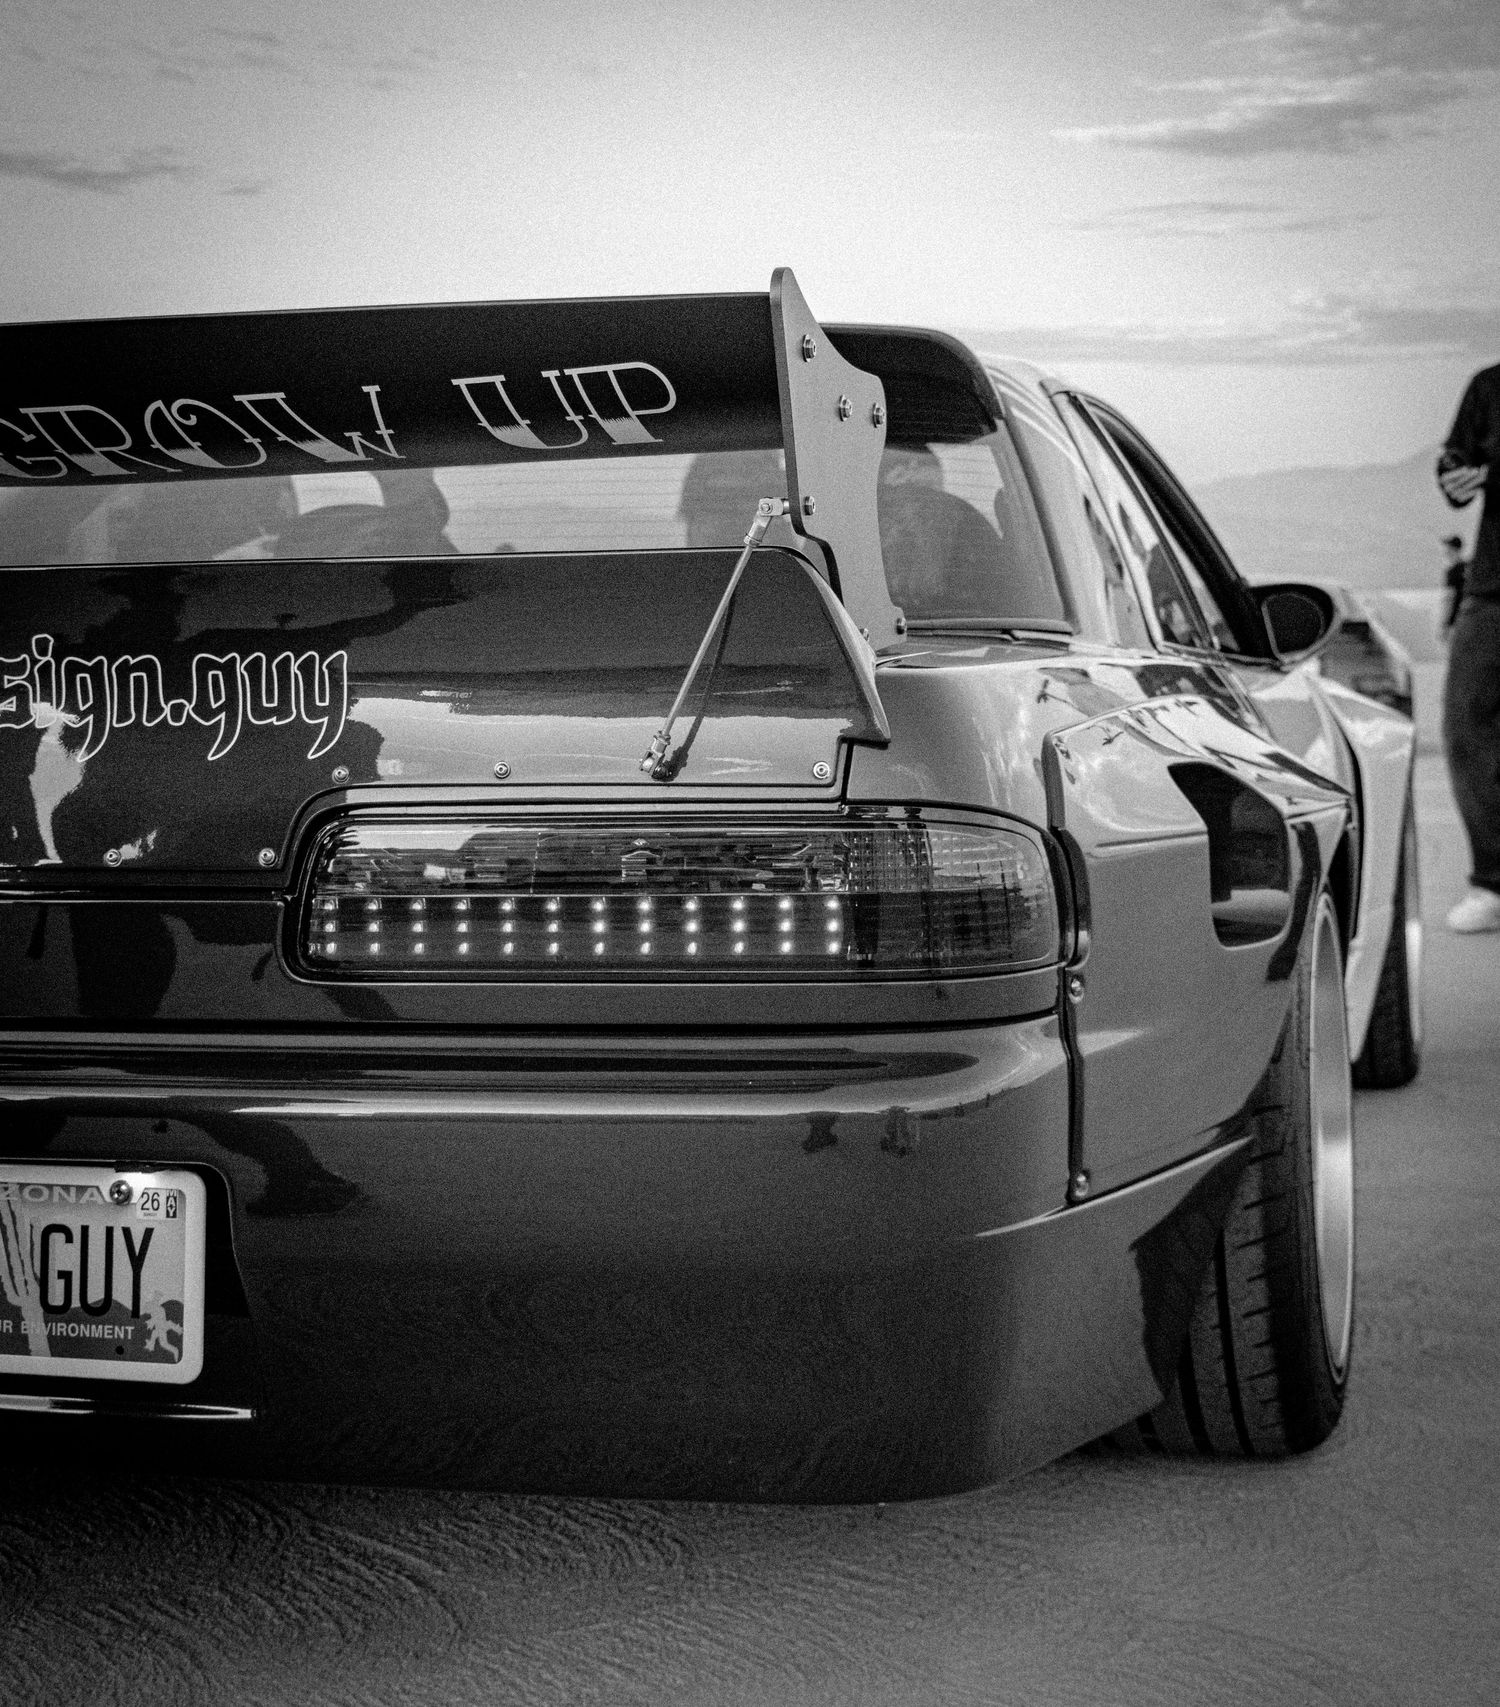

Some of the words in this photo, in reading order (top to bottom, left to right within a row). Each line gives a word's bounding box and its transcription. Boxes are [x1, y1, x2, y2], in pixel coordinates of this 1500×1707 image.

[451, 361, 677, 450] UP
[140, 1191, 160, 1211] 26
[39, 1223, 155, 1319] GUY
